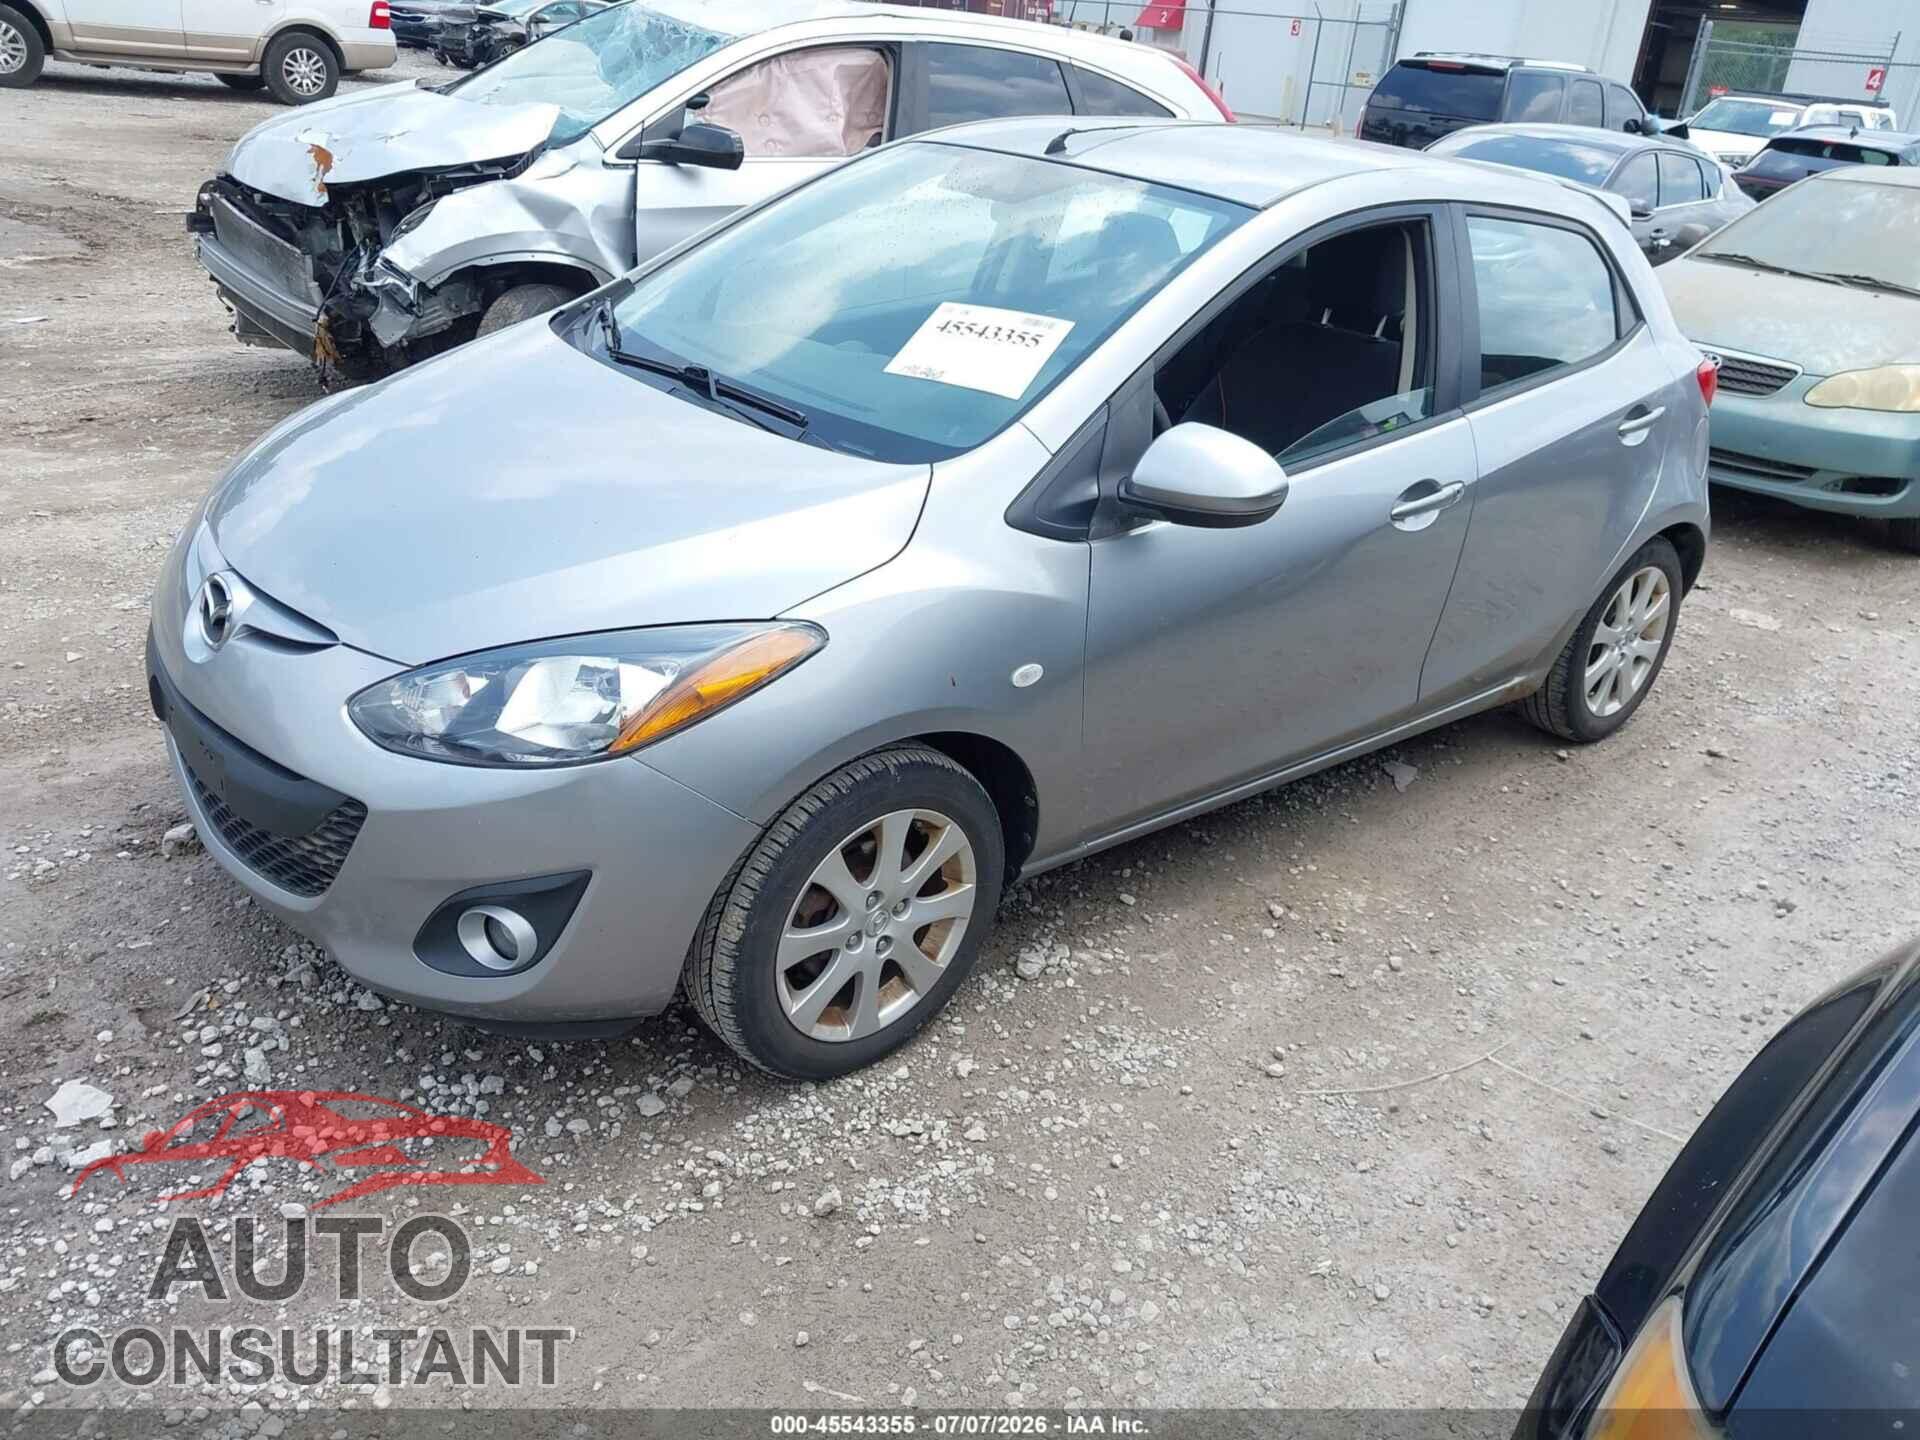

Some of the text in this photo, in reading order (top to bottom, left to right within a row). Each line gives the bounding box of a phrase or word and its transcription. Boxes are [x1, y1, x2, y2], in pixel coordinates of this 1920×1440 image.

[1159, 10, 1168, 24] 2
[1291, 20, 1301, 35] 3
[1868, 71, 1882, 89] 4
[935, 319, 1045, 348] 45543355
